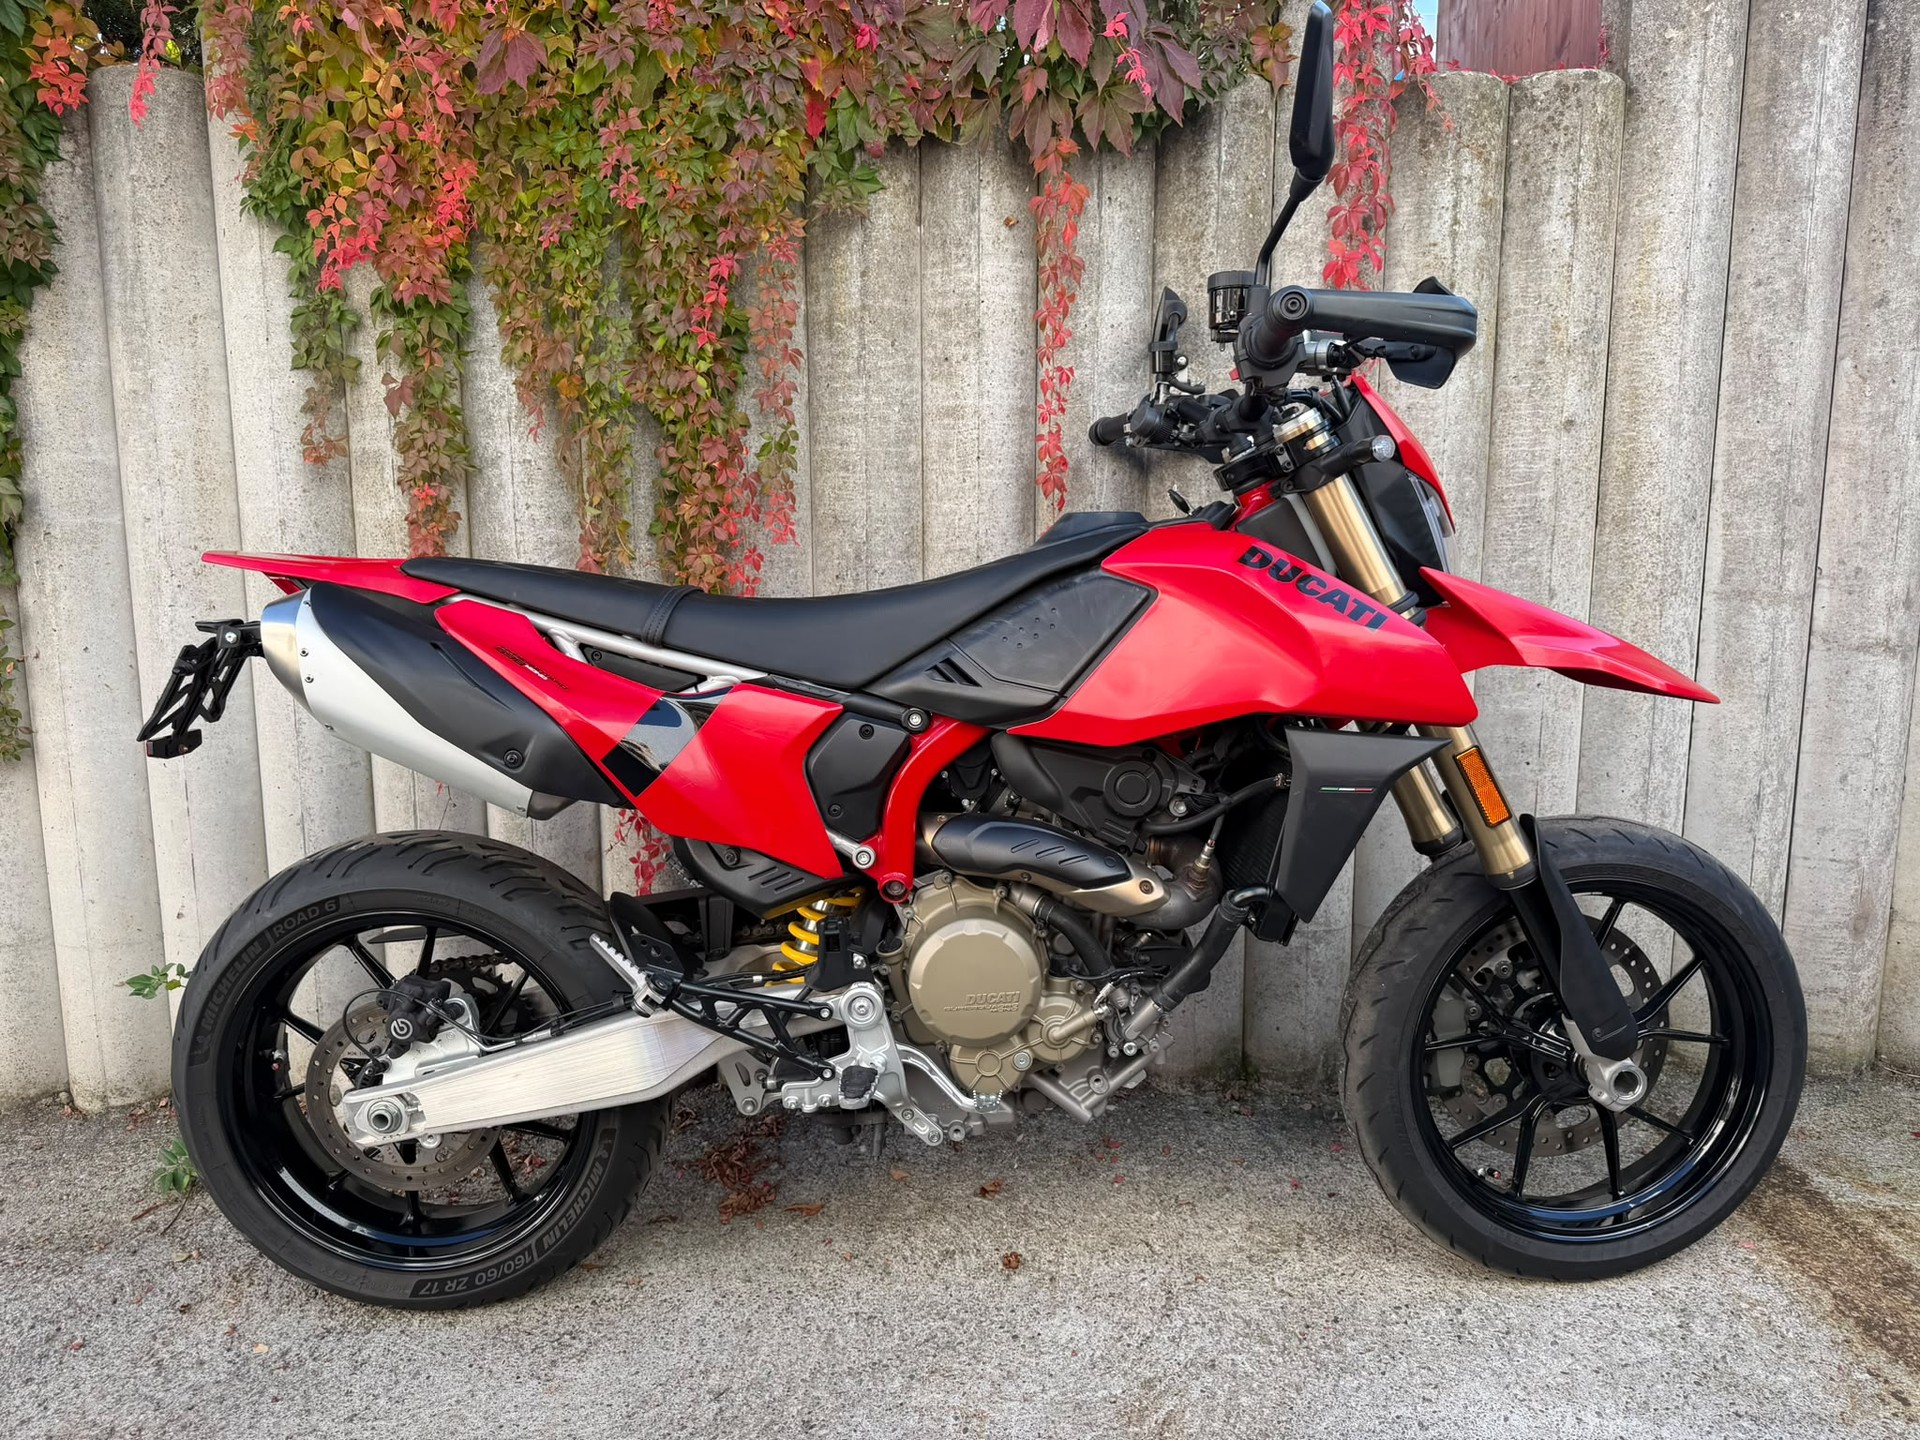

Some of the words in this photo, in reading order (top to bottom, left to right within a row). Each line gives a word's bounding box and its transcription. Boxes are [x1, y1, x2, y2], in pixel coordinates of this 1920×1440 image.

[1237, 545, 1388, 631] DUCATI
[202, 941, 263, 1032] MICHELIN
[273, 905, 320, 939] ROAD
[324, 899, 338, 912] 6
[965, 990, 1021, 1006] DUCATI
[542, 1160, 604, 1250] MICHELIN
[475, 1248, 533, 1286] 160/60
[419, 1282, 440, 1296] 17
[445, 1281, 468, 1293] ZR
